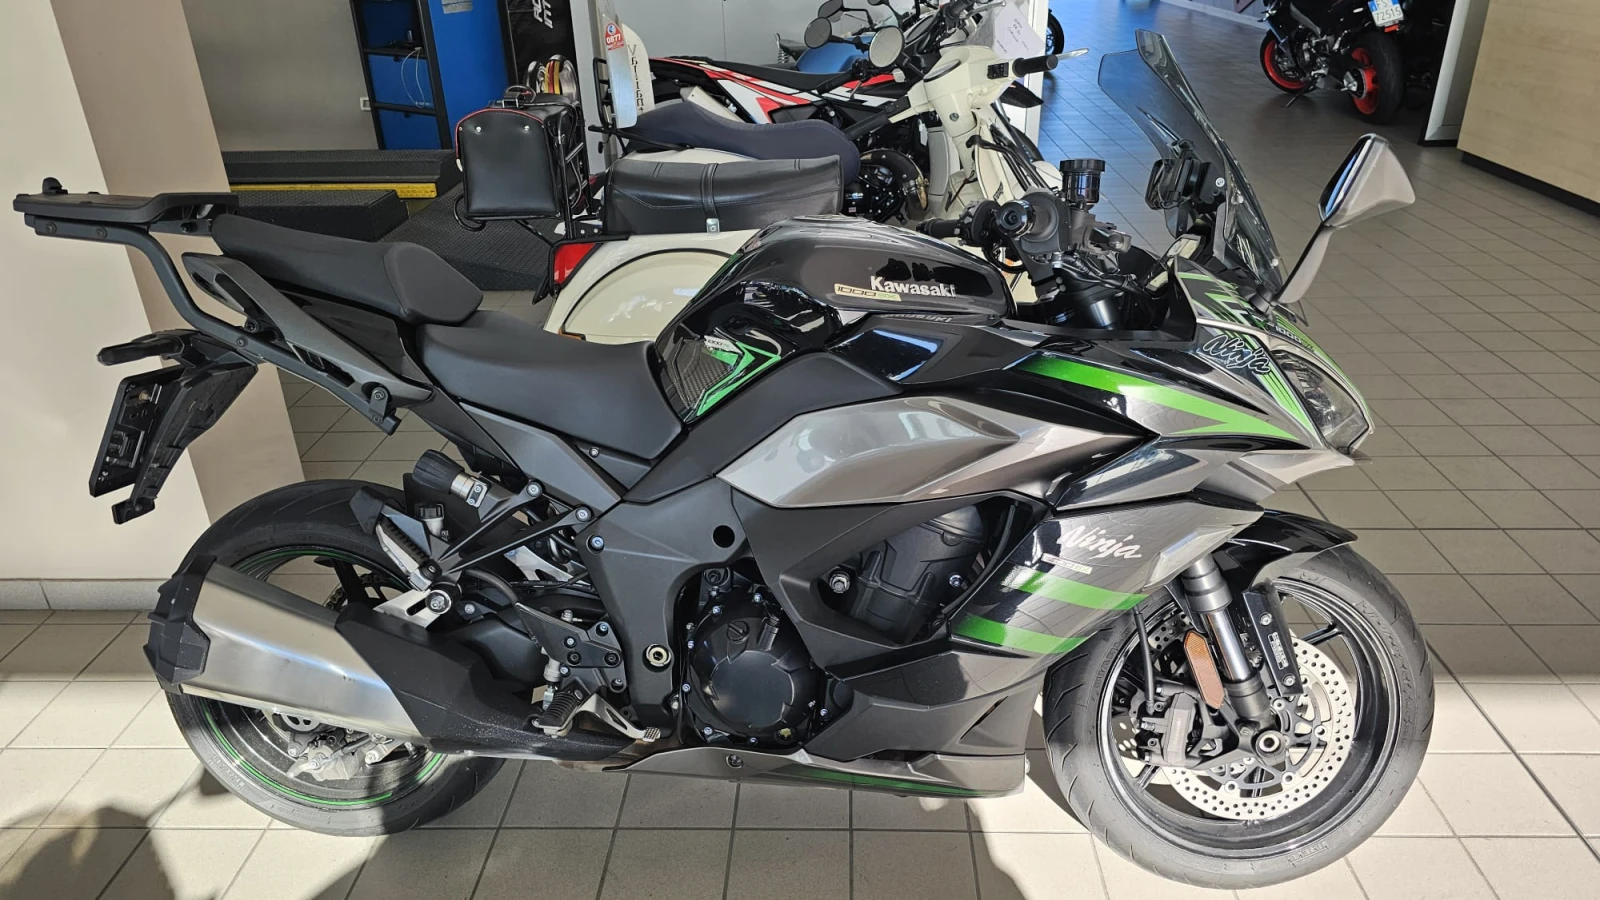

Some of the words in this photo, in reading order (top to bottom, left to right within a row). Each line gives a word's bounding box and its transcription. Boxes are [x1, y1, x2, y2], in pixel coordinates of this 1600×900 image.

[870, 275, 957, 297] Kawasaki
[1203, 334, 1271, 373] Ninja
[1056, 525, 1142, 560] Ninja
